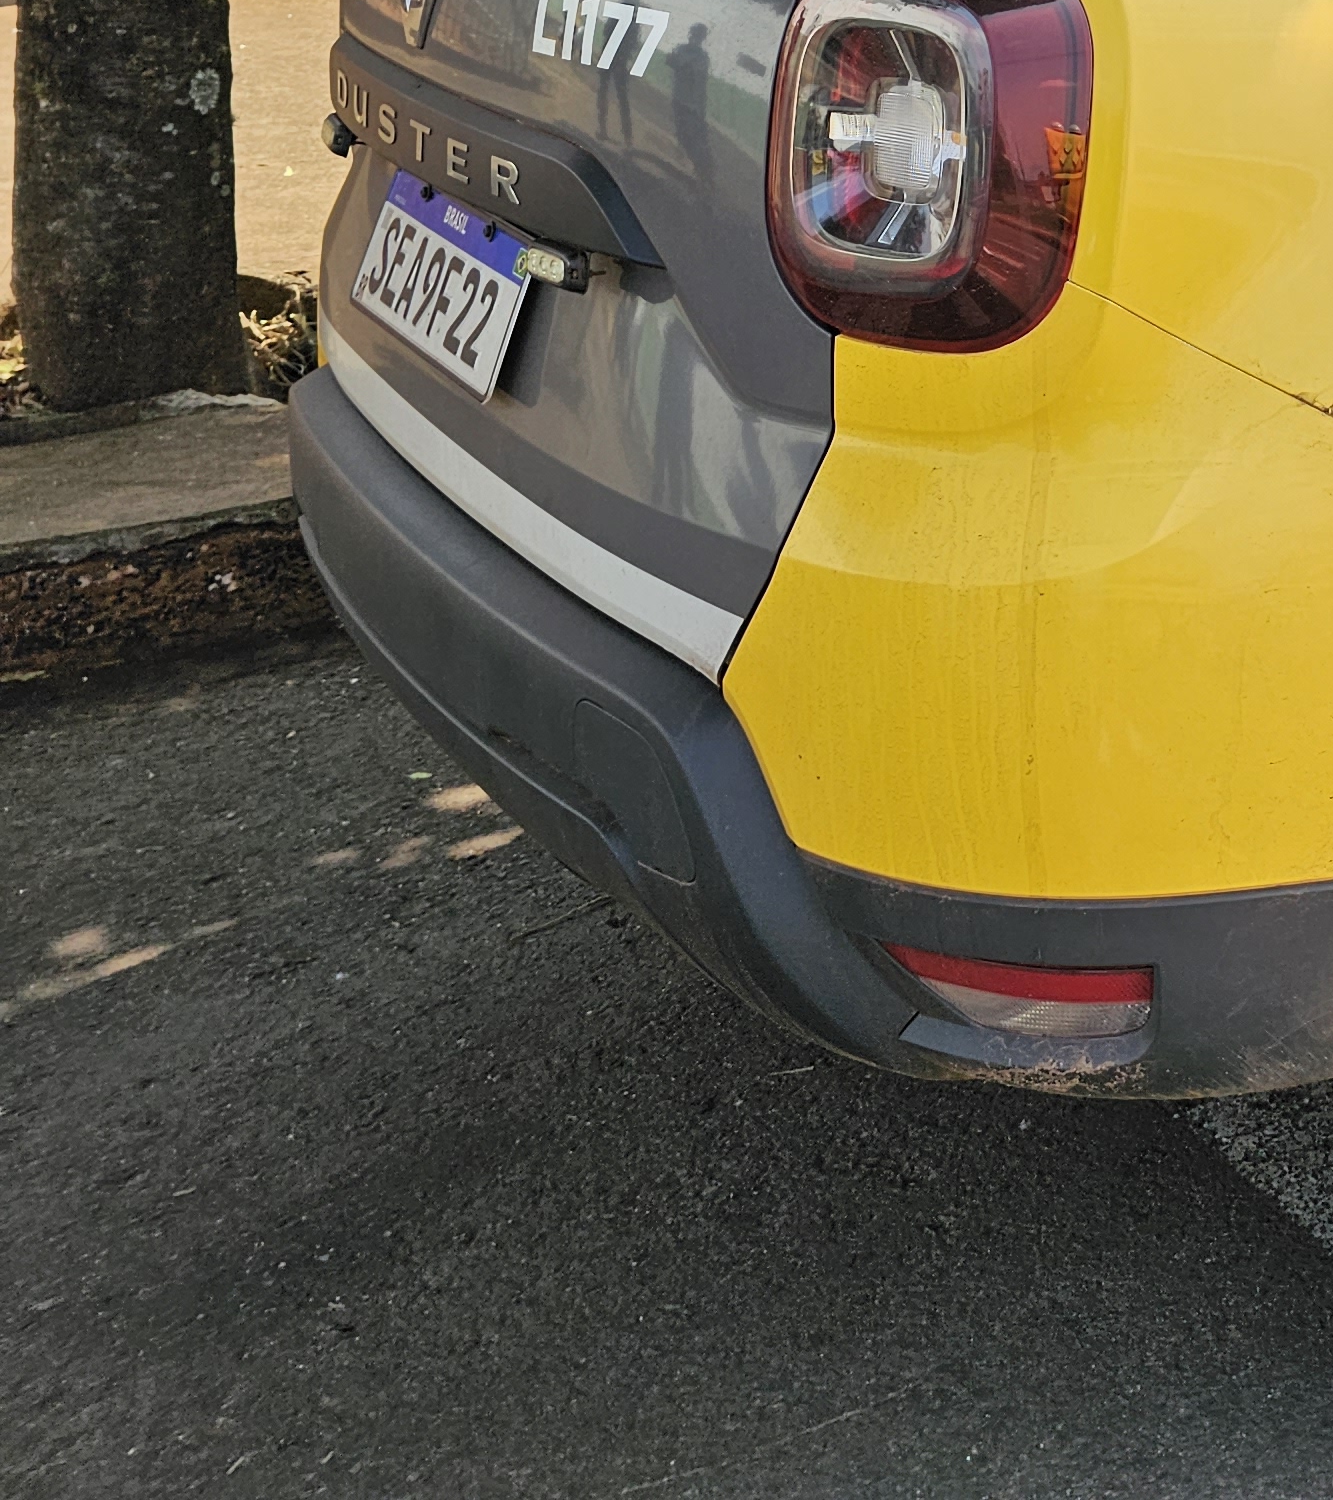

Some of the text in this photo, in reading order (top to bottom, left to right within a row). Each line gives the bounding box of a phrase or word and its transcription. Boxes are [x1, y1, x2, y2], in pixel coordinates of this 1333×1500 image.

[337, 69, 520, 205] DUSTER
[443, 204, 470, 235] BRASIL
[368, 217, 499, 371] SEA9F22
